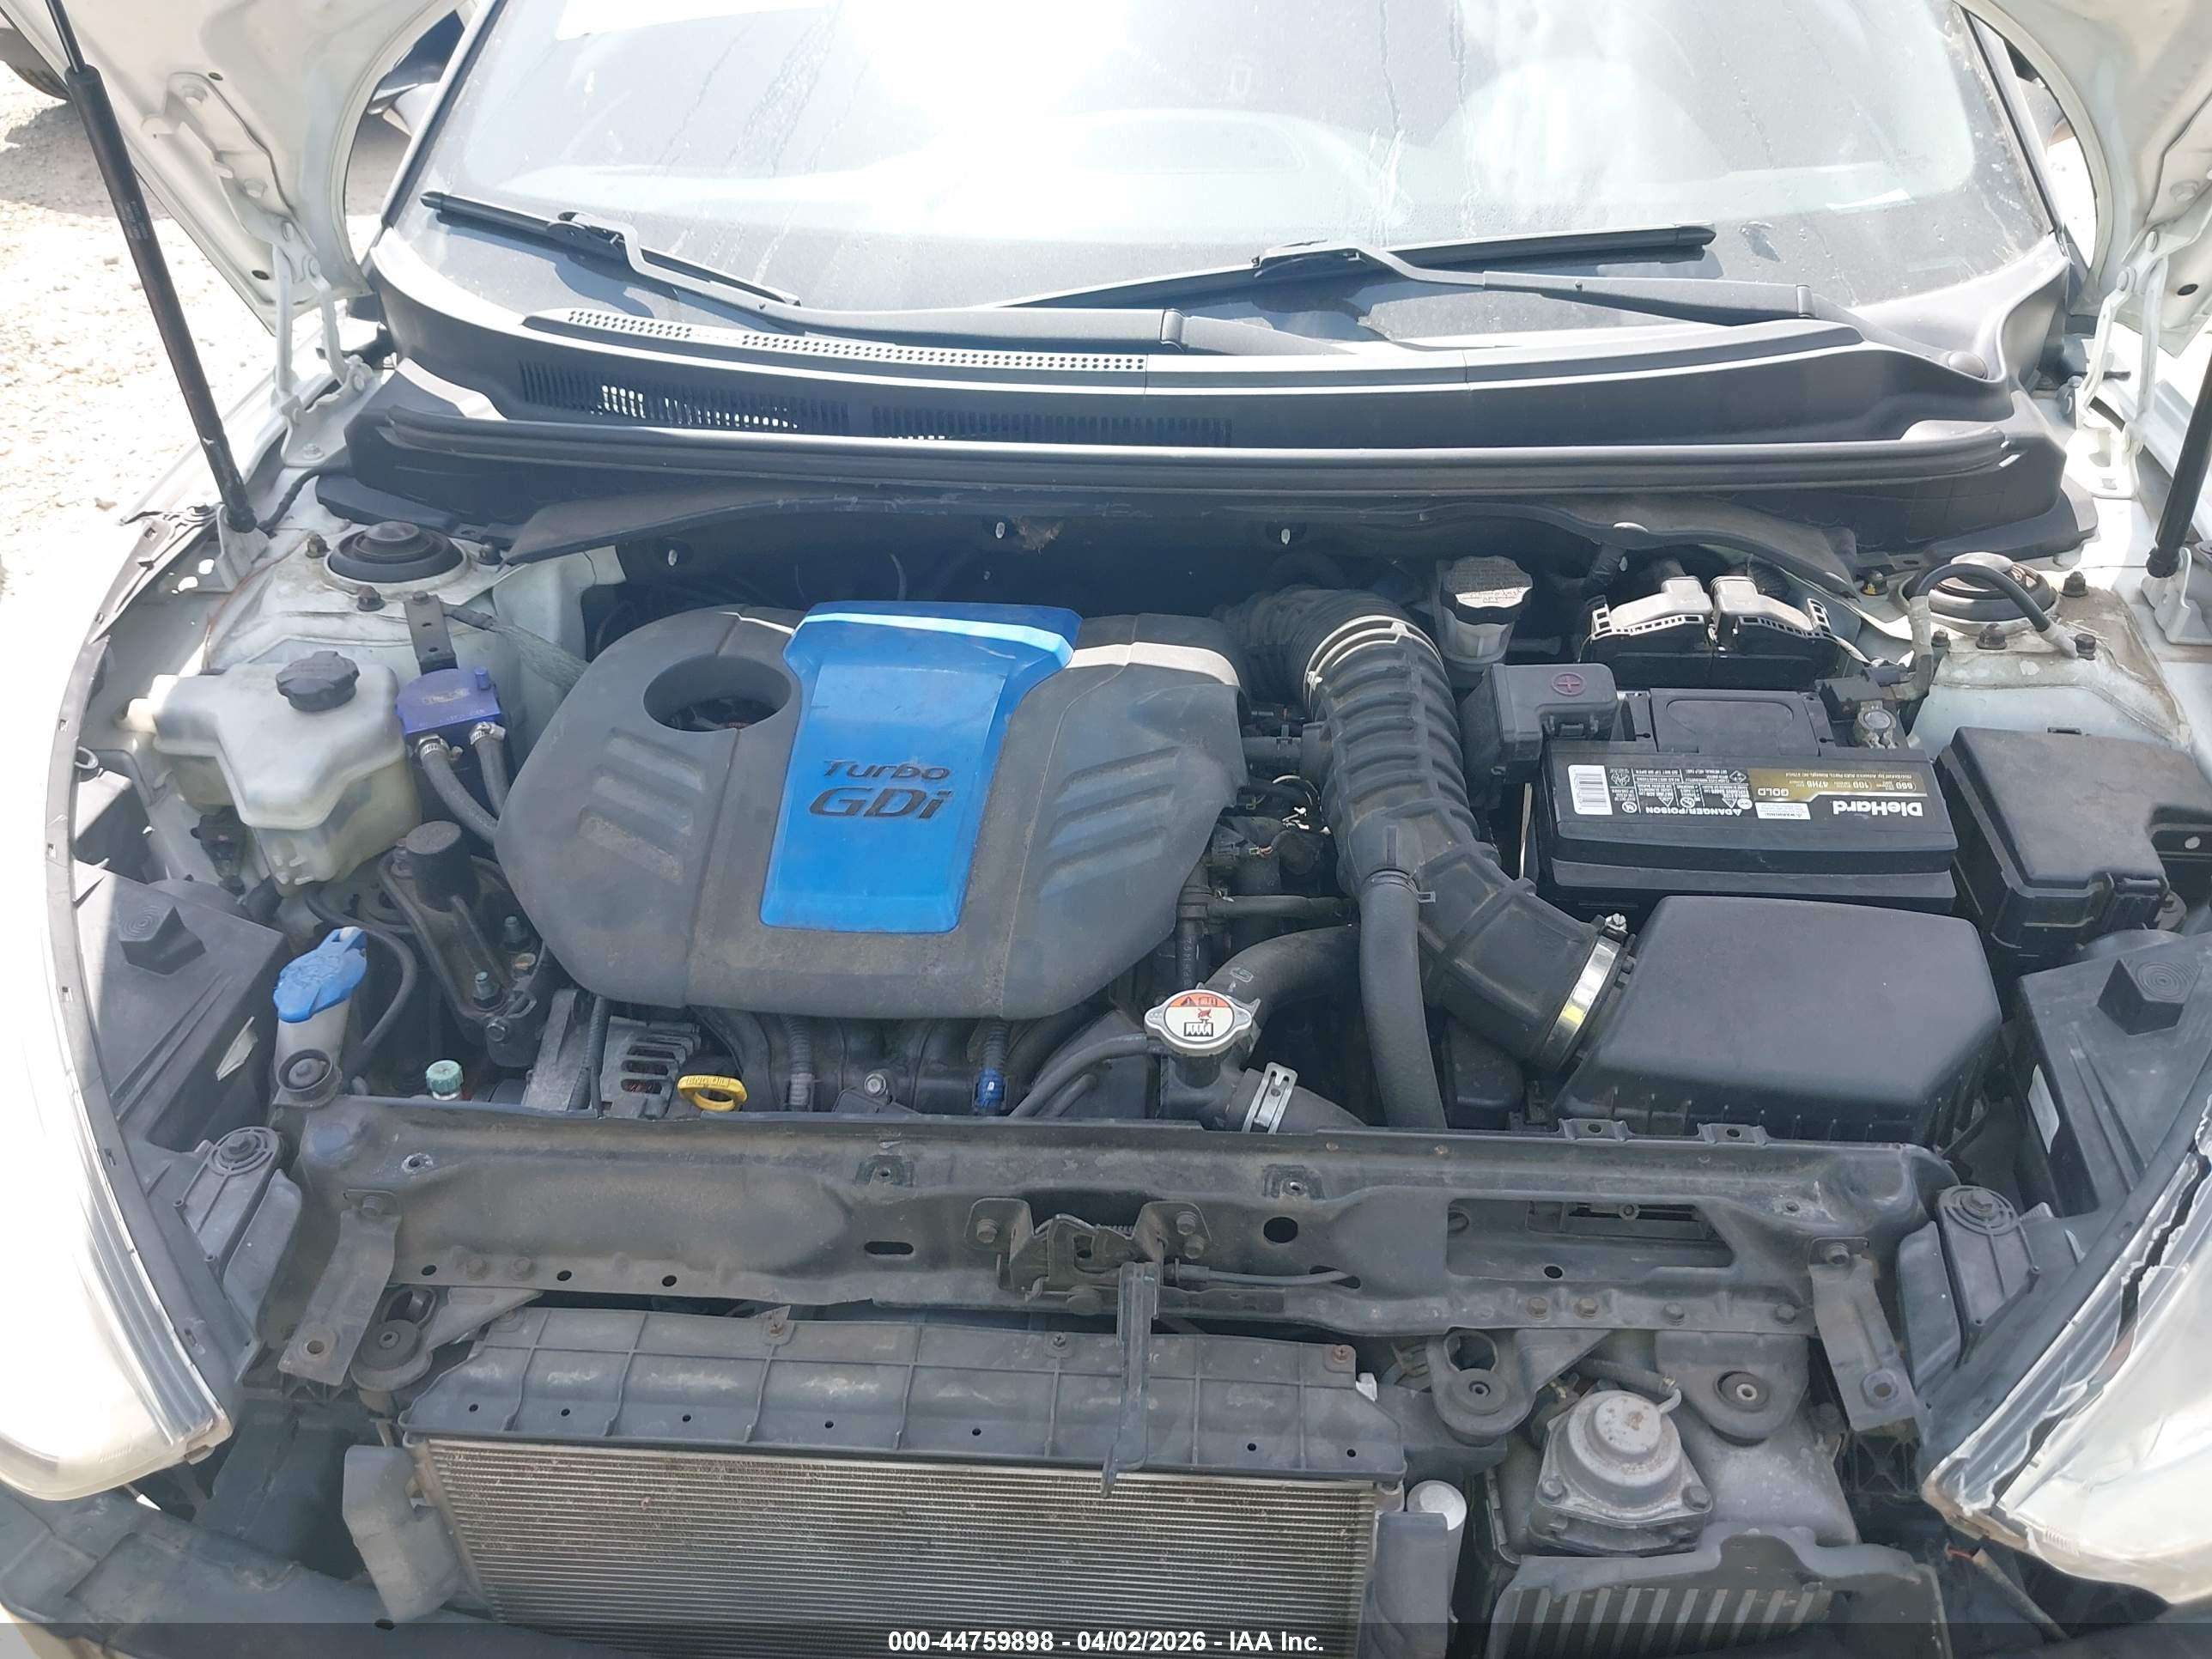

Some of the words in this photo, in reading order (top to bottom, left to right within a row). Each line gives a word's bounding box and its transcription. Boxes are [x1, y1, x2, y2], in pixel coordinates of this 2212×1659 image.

[823, 759, 951, 781] Turbo
[1757, 787, 1790, 797] GOLD
[810, 787, 951, 818] GDi
[1832, 800, 1923, 817] DieHard
